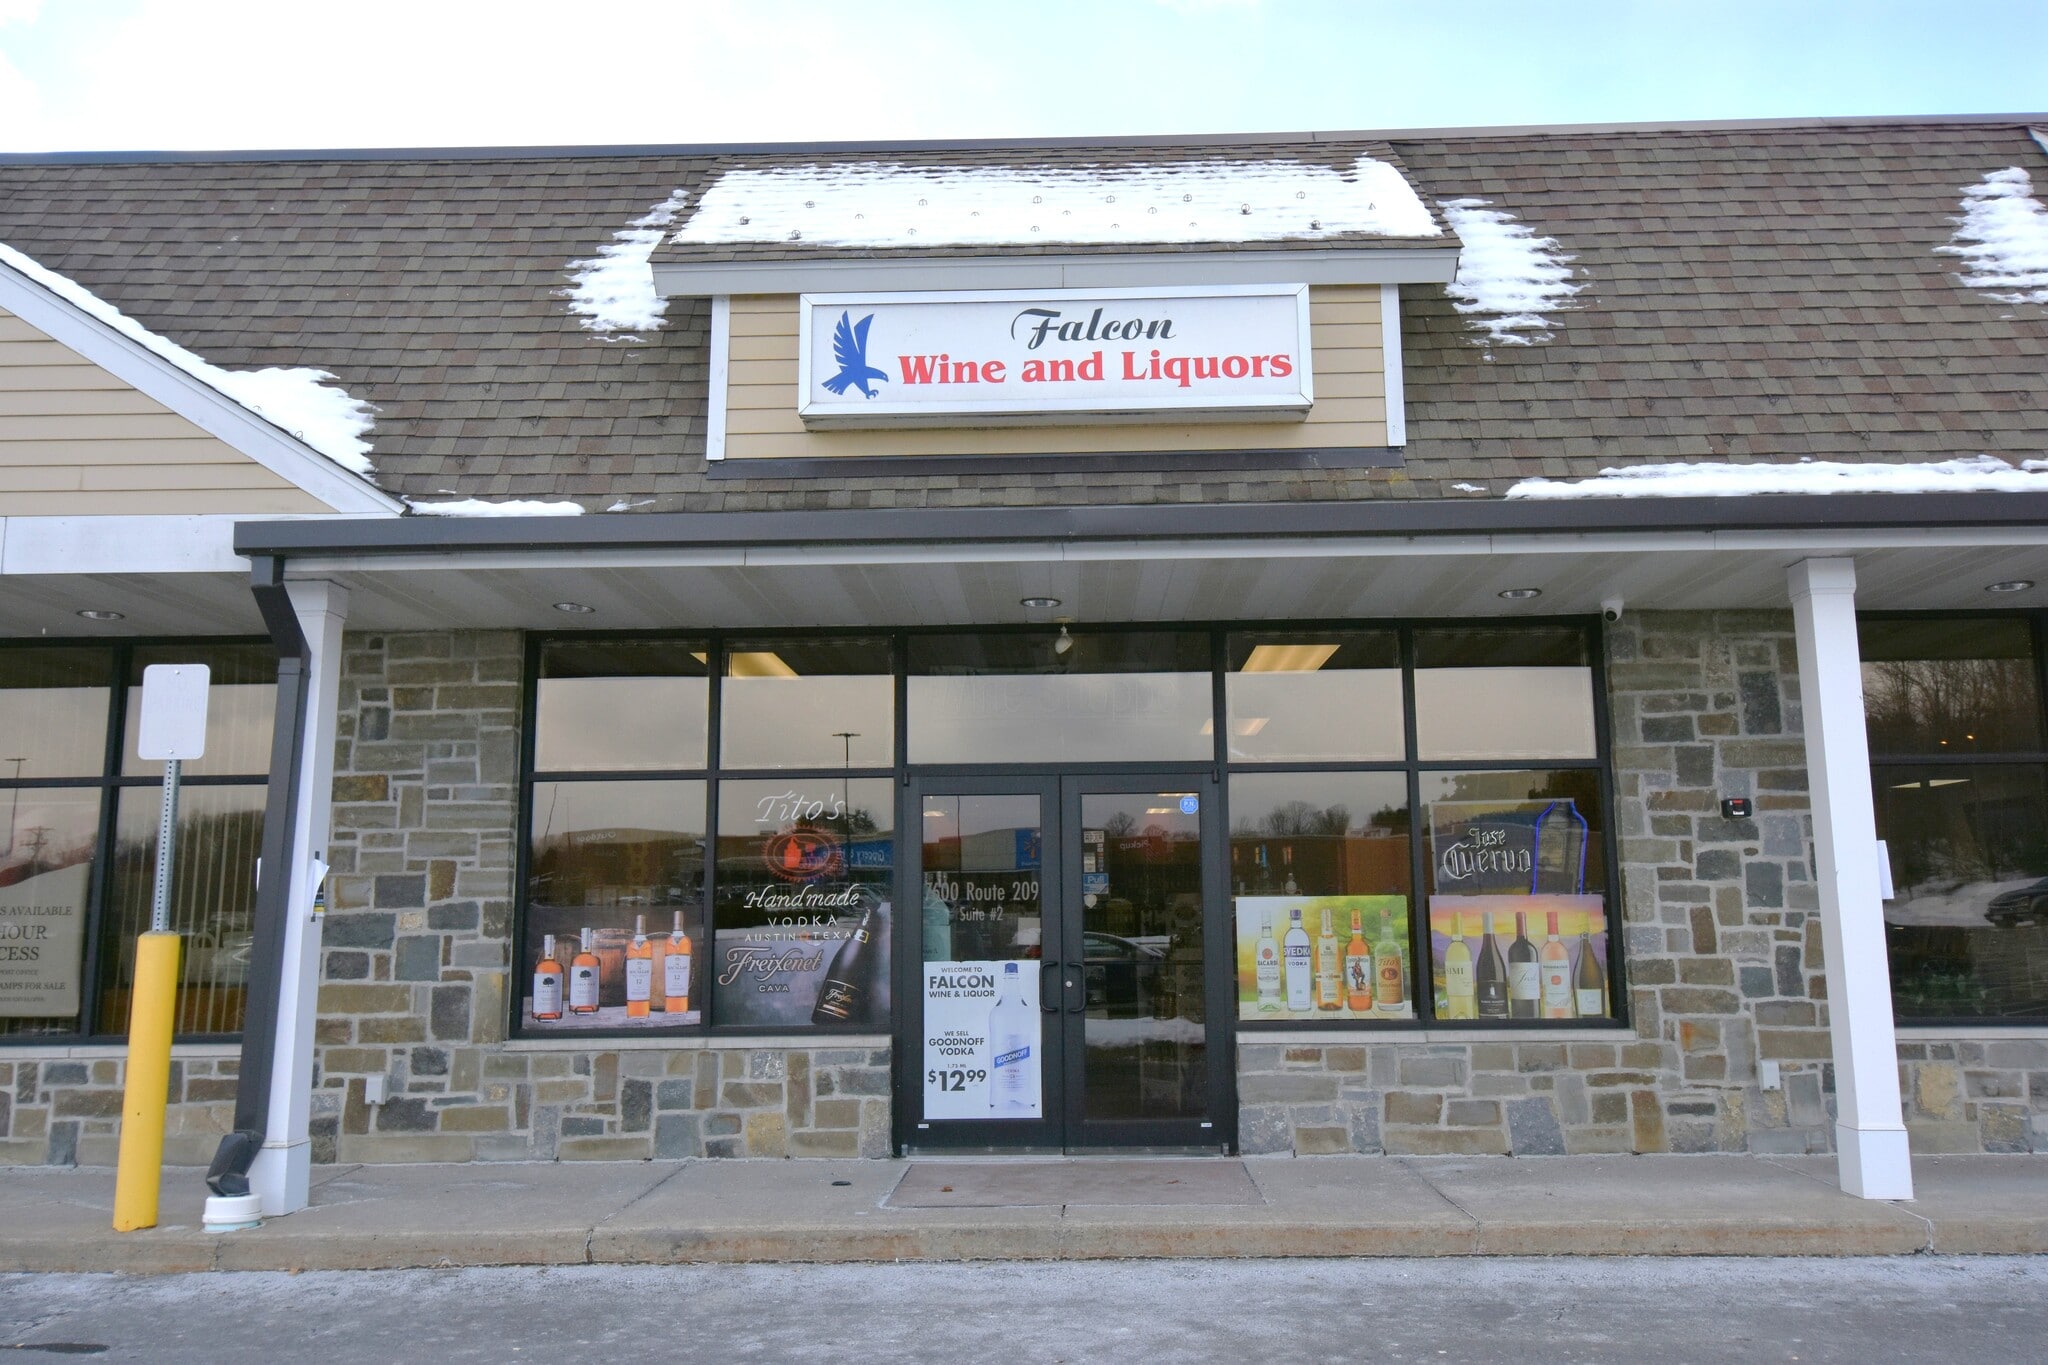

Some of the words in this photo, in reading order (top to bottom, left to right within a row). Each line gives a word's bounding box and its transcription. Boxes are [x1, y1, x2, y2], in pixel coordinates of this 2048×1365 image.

[1011, 307, 1176, 350] Falcon
[898, 353, 1006, 385] Wine
[1021, 350, 1104, 382] and
[1121, 348, 1293, 388] Liquors
[754, 790, 846, 822] Tito's
[1443, 842, 1531, 880] Cuervo
[1087, 875, 1104, 884] Pull
[743, 884, 860, 909] Handmade
[966, 882, 1006, 901] Route
[1012, 881, 1039, 901] 209
[8, 906, 73, 916] AVAILABLE
[959, 906, 985, 921] Suite
[989, 907, 1004, 921] #2
[767, 914, 838, 929] VODKA
[744, 933, 796, 943] AUSTIN
[813, 931, 852, 940] TEXA
[718, 946, 825, 986] Freixenet
[24, 982, 42, 990] FOR
[43, 982, 66, 990] SALE
[758, 984, 790, 993] CAVA
[929, 975, 994, 989] FALCON
[928, 990, 951, 998] WINE
[954, 990, 960, 998] &
[963, 990, 995, 998] LIQUOR
[928, 1038, 985, 1047] GOODNOFF
[939, 1047, 975, 1056] VODKA
[996, 1049, 1027, 1064] GOODNOFF
